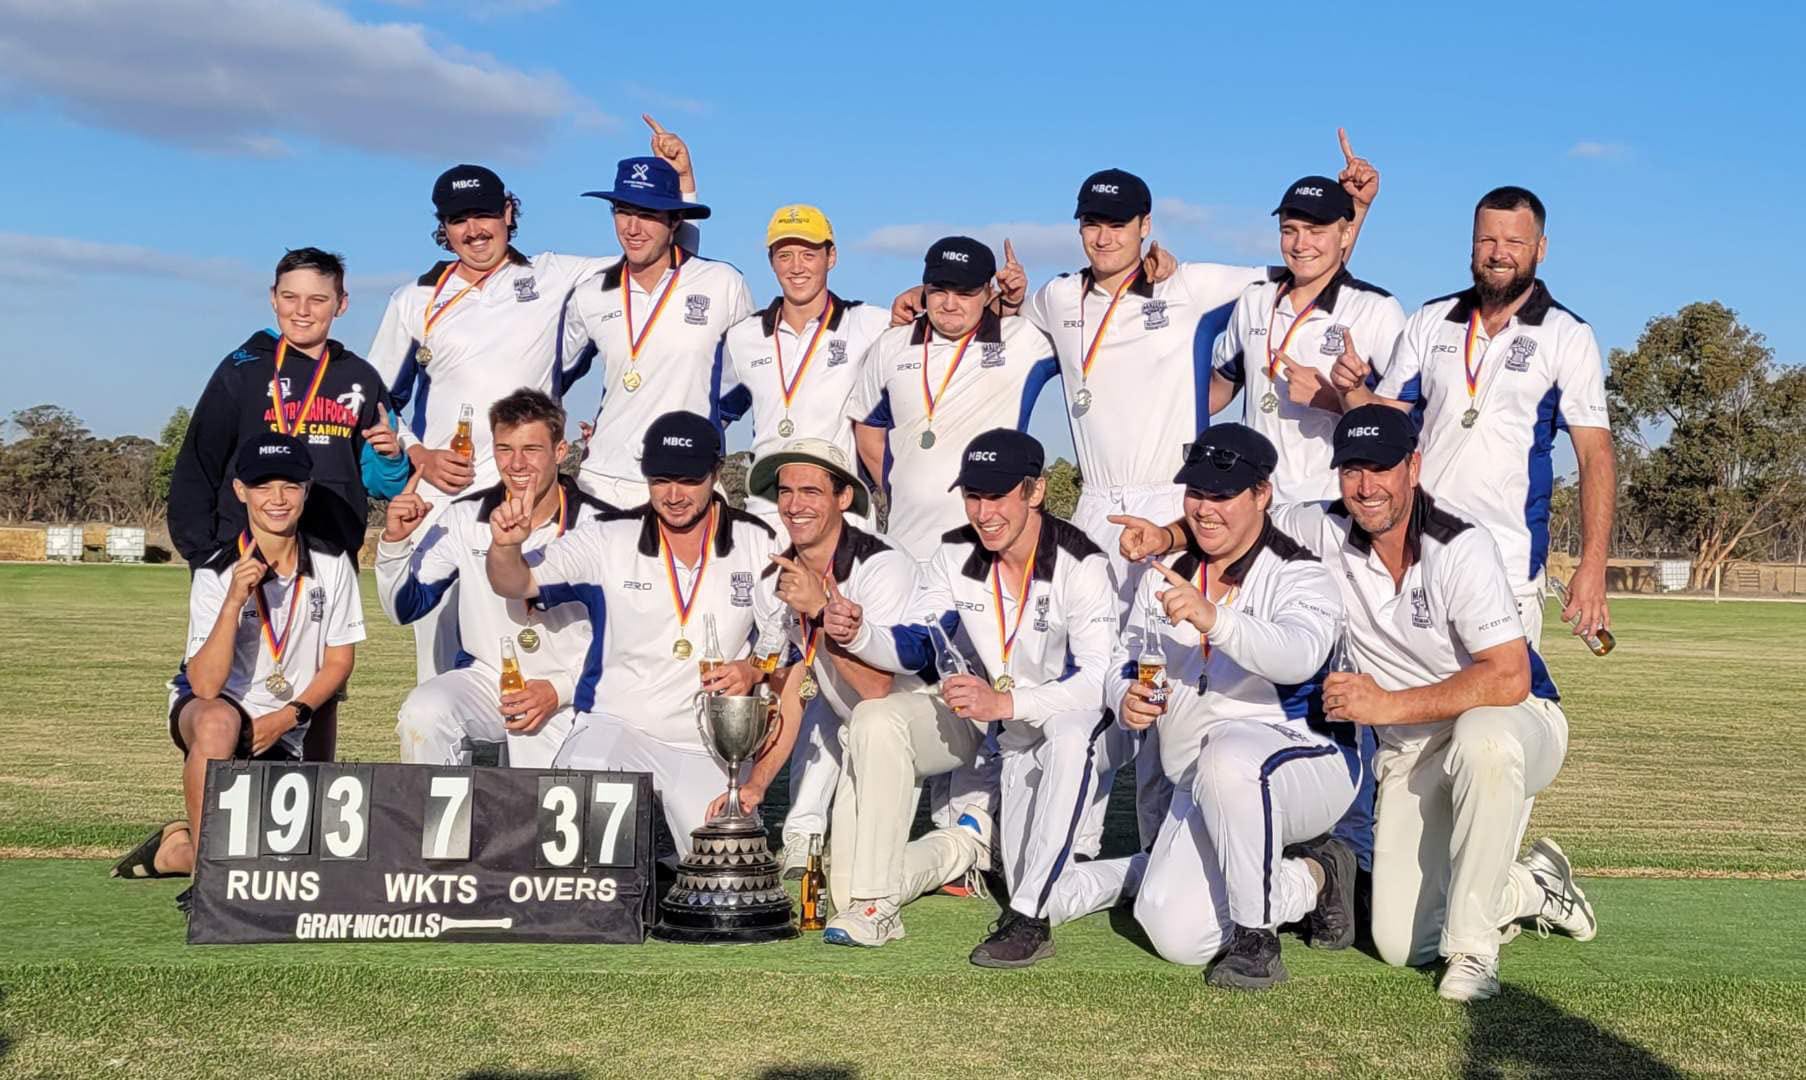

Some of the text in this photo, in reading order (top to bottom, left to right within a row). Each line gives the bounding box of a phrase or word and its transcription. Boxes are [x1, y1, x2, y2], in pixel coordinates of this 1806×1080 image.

[452, 179, 481, 190] MBCC
[1091, 184, 1119, 194] MBCC
[1295, 186, 1324, 197] MBCC
[942, 250, 969, 263] MBCC
[1347, 426, 1380, 438] MBCC
[663, 436, 693, 448] MBCC
[259, 445, 291, 455] MBCC
[968, 451, 997, 462] MBCC
[219, 772, 634, 867] 193 7 37
[227, 870, 617, 904] RUNS WKTS OVERS
[296, 912, 441, 940] GRAY-NICOLLS
